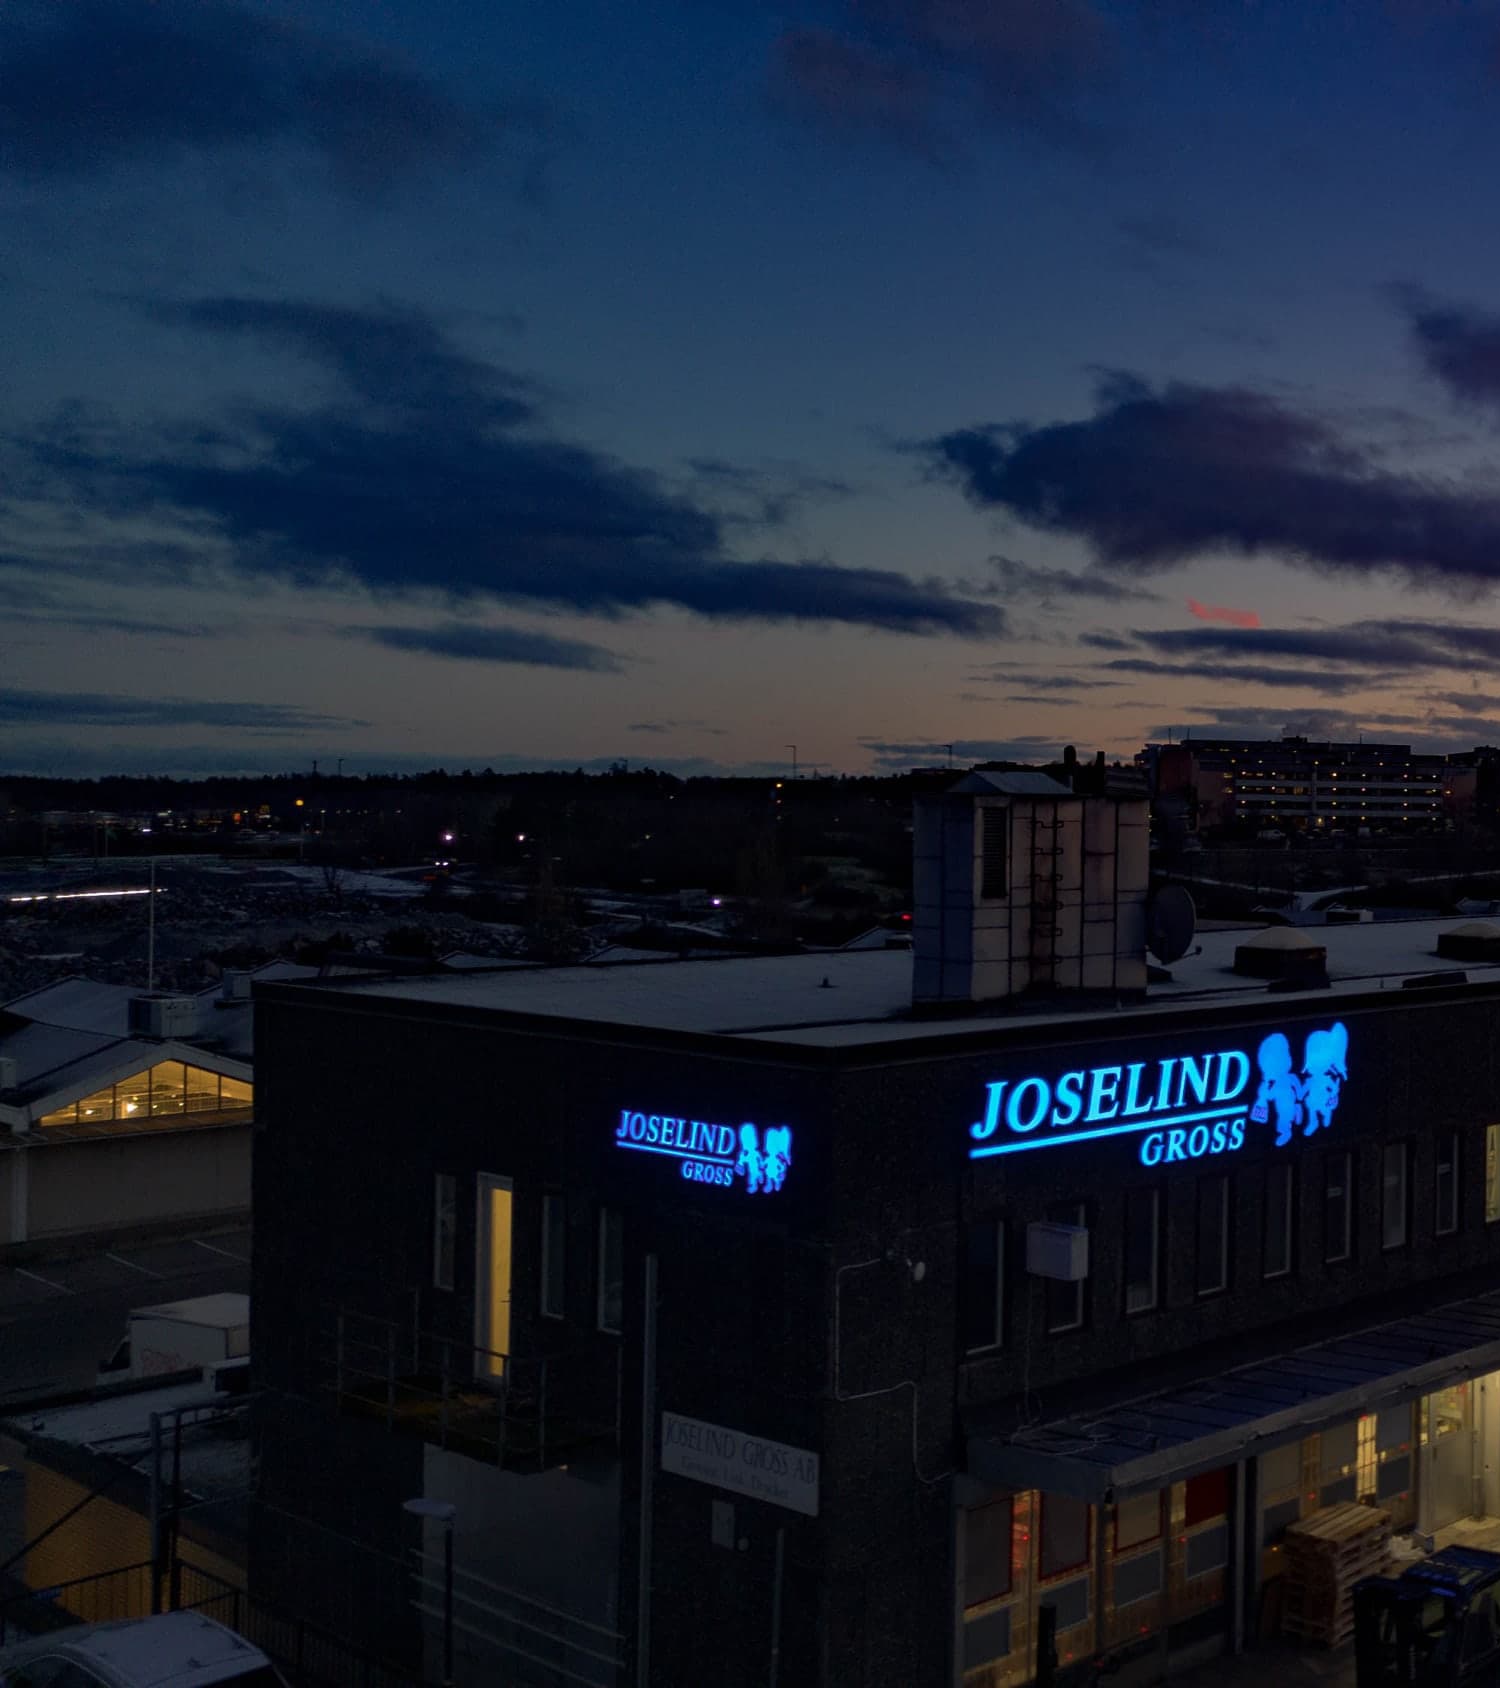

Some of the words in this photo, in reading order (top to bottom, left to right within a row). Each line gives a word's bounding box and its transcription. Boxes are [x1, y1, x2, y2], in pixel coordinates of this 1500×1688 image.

[970, 1050, 1250, 1140] JOSELIND
[616, 1109, 736, 1155] JOSELIND
[1140, 1119, 1247, 1167] GROSS
[681, 1160, 734, 1187] GROSS
[663, 1417, 736, 1459] JOSELIND
[743, 1440, 790, 1477] GROSS
